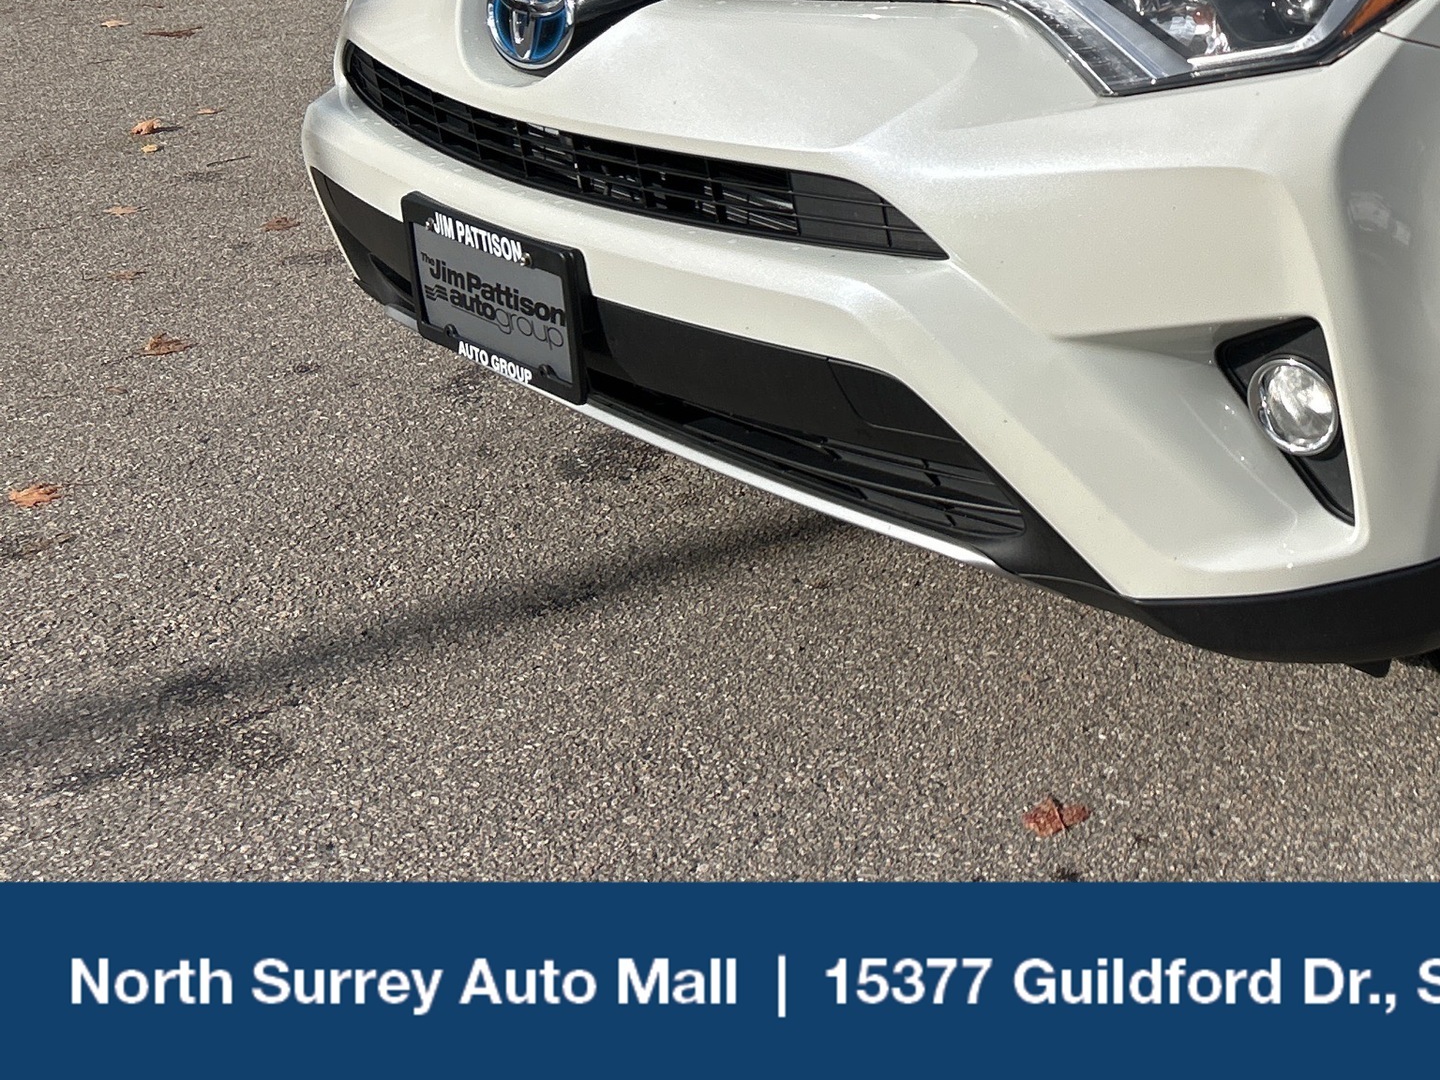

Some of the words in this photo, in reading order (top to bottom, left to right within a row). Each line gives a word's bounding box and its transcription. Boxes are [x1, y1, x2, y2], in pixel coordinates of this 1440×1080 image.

[420, 251, 435, 266] The
[433, 211, 455, 240] JIM
[456, 219, 523, 263] PATTISON
[458, 340, 489, 370] AUTO
[490, 354, 533, 384] GROUP
